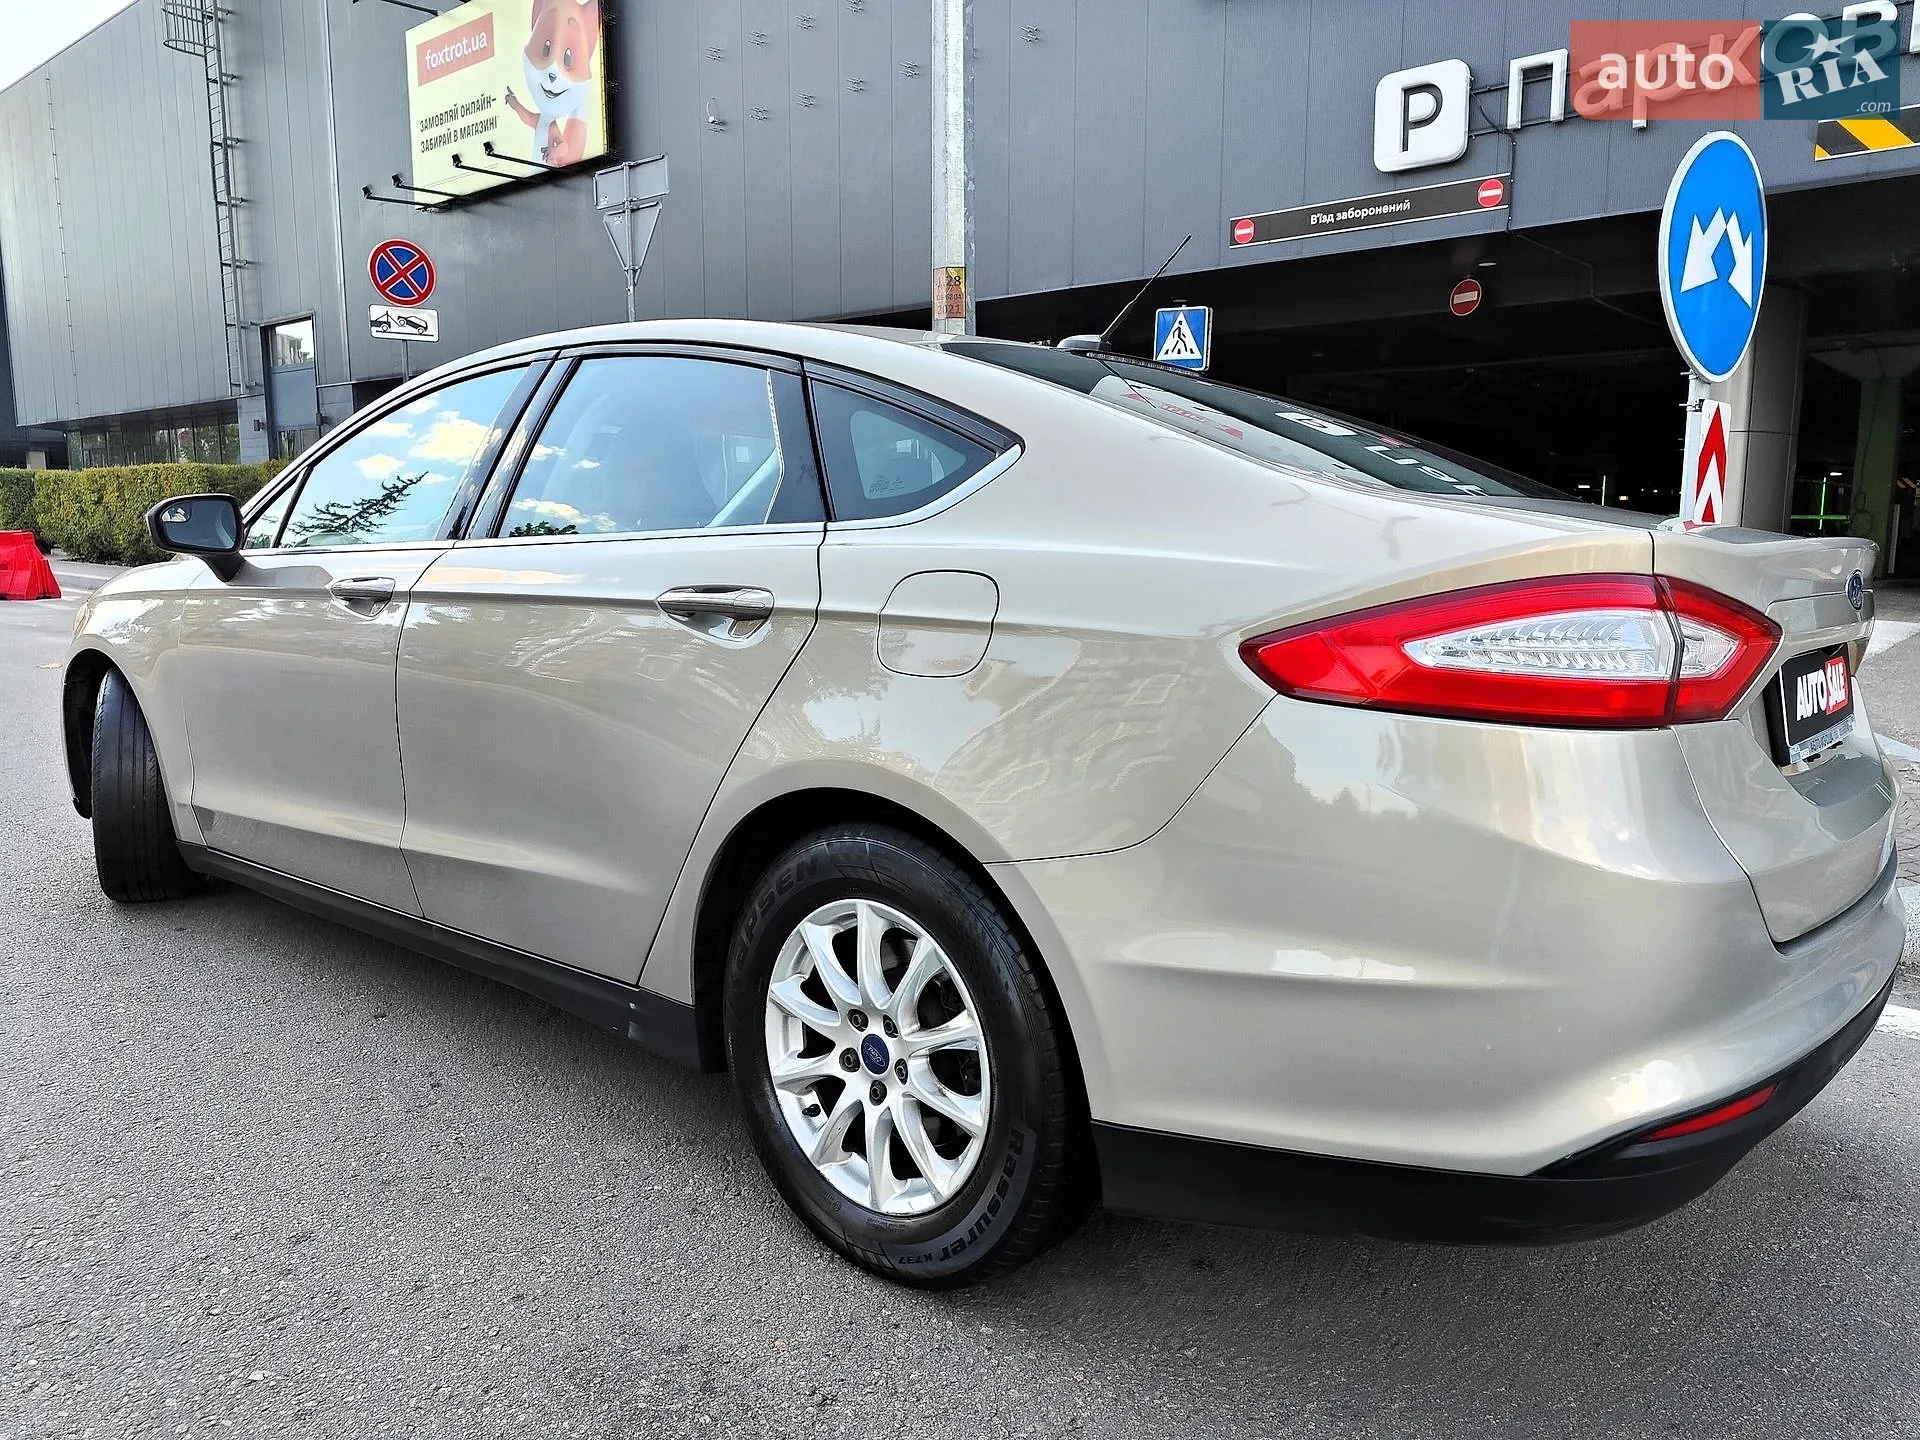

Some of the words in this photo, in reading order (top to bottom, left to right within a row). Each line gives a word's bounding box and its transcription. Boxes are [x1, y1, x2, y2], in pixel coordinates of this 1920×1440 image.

[425, 31, 488, 70] foxtrot.ua
[419, 103, 459, 133] ЗАМОВЛЯЙ
[420, 127, 452, 154] ЗАБИРАЙ
[453, 129, 459, 143] В
[459, 115, 498, 141] МАГАЗИНІ
[1335, 199, 1411, 220] заборонений
